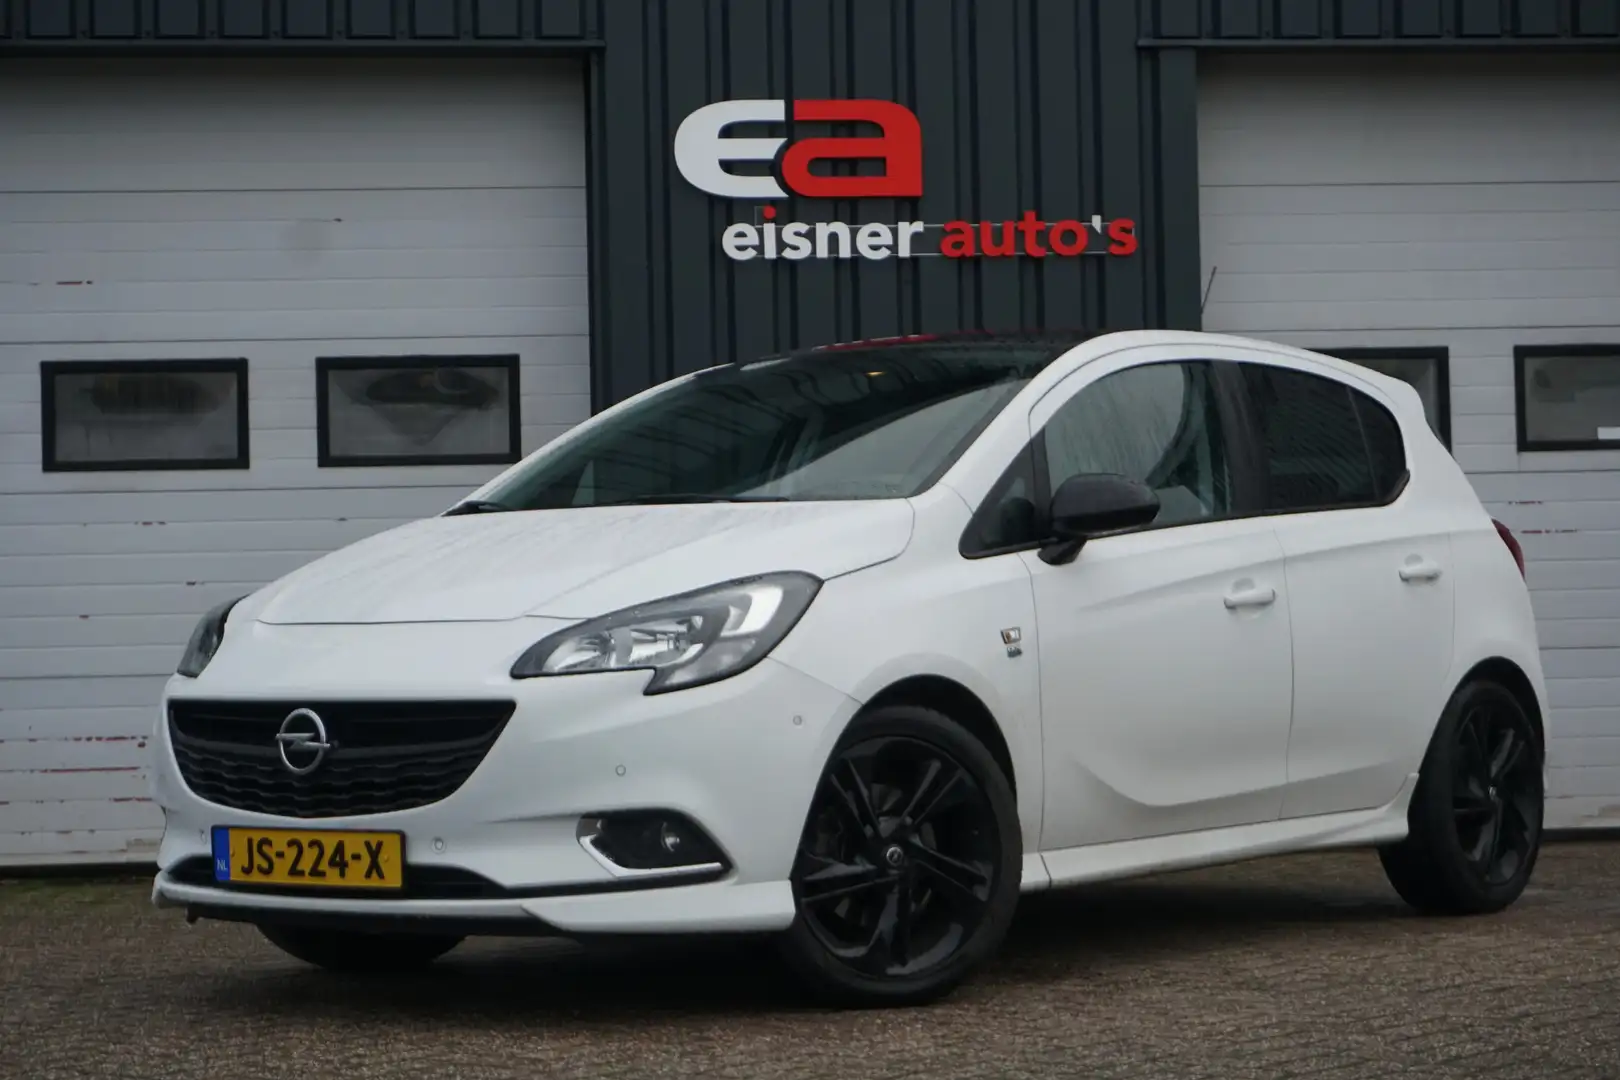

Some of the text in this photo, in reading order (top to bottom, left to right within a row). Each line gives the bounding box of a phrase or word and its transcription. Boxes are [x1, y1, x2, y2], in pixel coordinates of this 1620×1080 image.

[674, 99, 922, 197] ea
[722, 206, 1138, 260] eisner auto's
[217, 859, 228, 871] NL
[241, 837, 385, 879] JS-224-X
